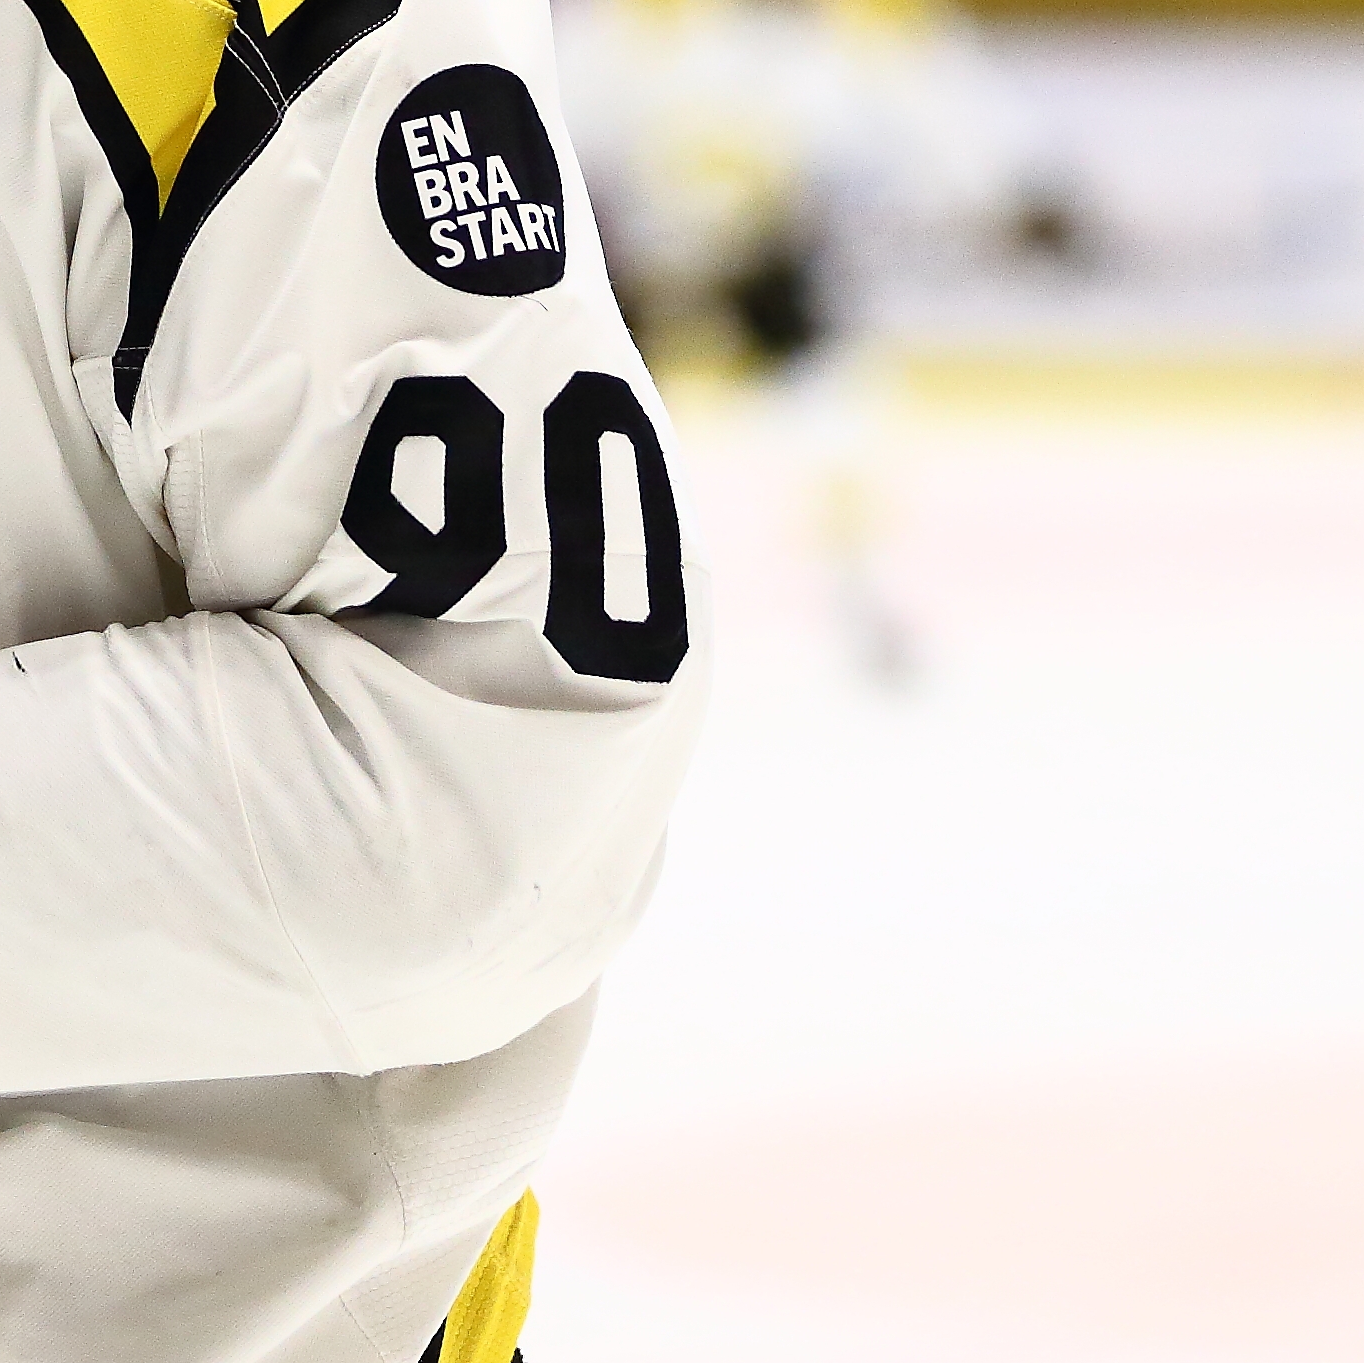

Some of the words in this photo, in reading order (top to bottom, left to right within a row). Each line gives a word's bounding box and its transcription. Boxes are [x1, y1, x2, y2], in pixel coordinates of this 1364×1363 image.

[400, 110, 472, 169] EN
[414, 155, 521, 221] BRA
[429, 203, 561, 269] START
[331, 370, 690, 684] 90
